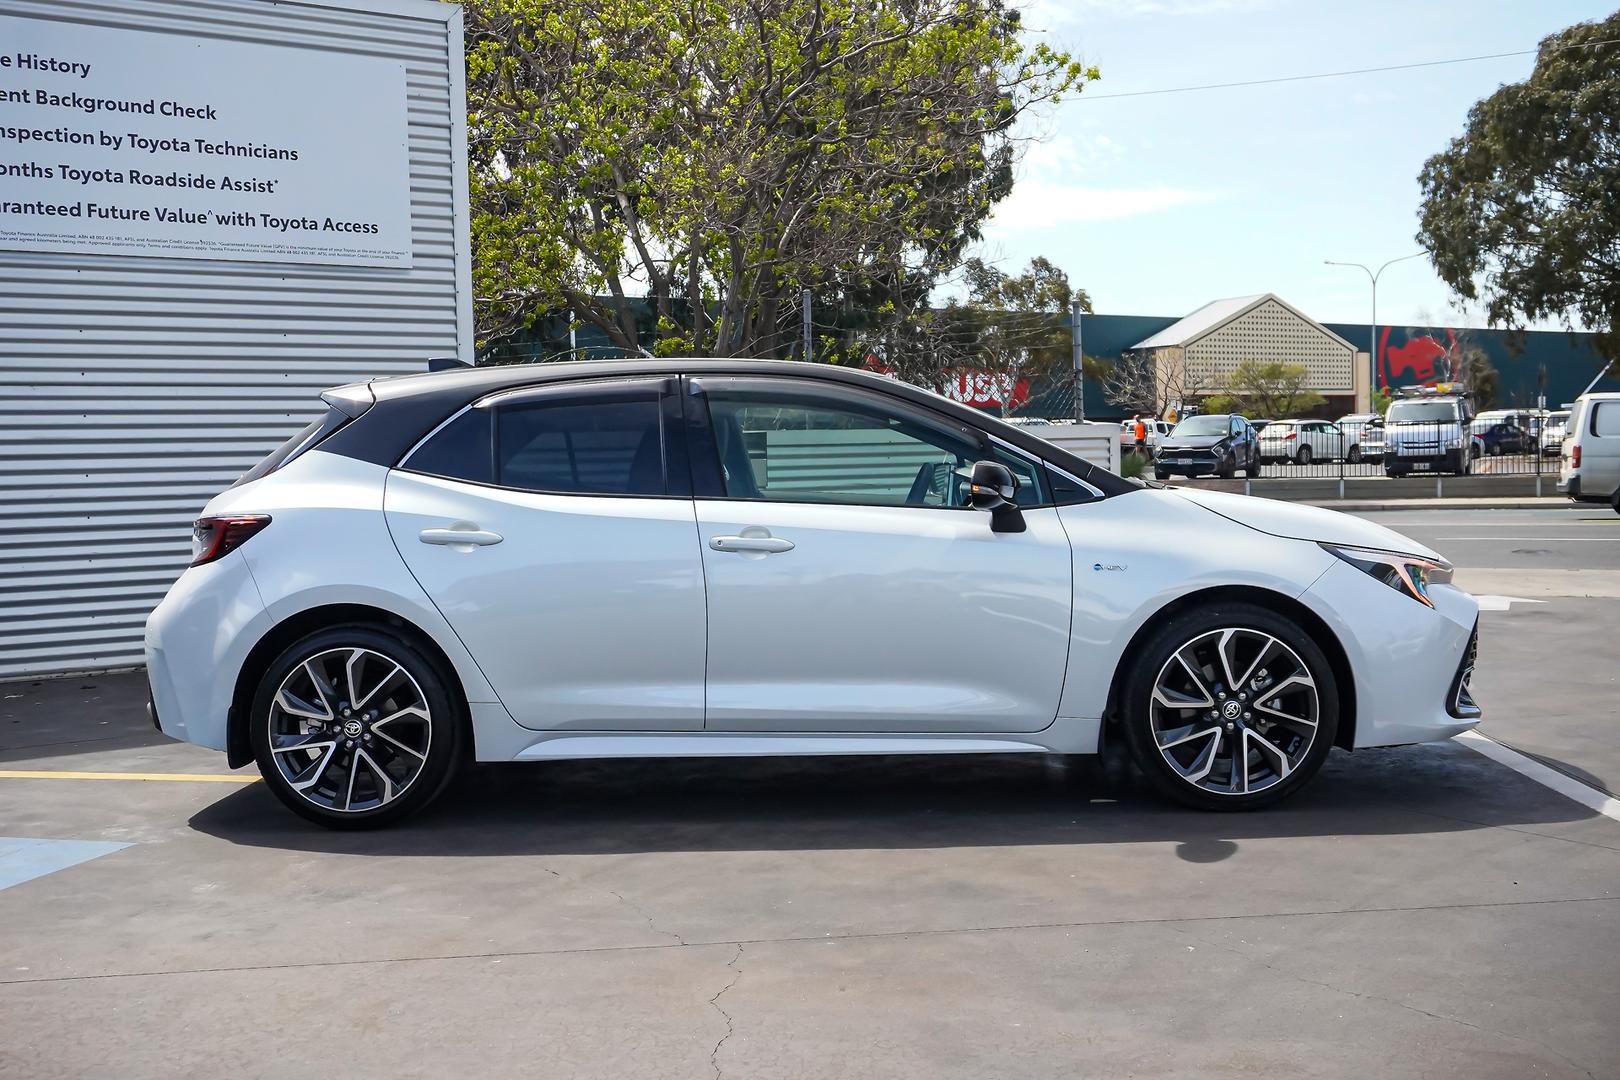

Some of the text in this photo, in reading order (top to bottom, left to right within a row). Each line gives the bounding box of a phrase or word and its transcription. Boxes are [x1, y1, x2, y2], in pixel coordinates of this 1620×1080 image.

[0, 54, 91, 78] e History
[0, 89, 216, 120] ent Background Check
[100, 131, 122, 150] by
[128, 134, 190, 153] Toyota
[195, 139, 298, 160] Technicians
[0, 162, 53, 178] onths
[59, 165, 123, 184] Toyota
[130, 170, 215, 189] Roadside
[0, 201, 81, 217] ranteed
[87, 204, 150, 220] Future
[216, 212, 255, 227] with
[260, 213, 318, 232] Toyota
[323, 218, 378, 233] Access
